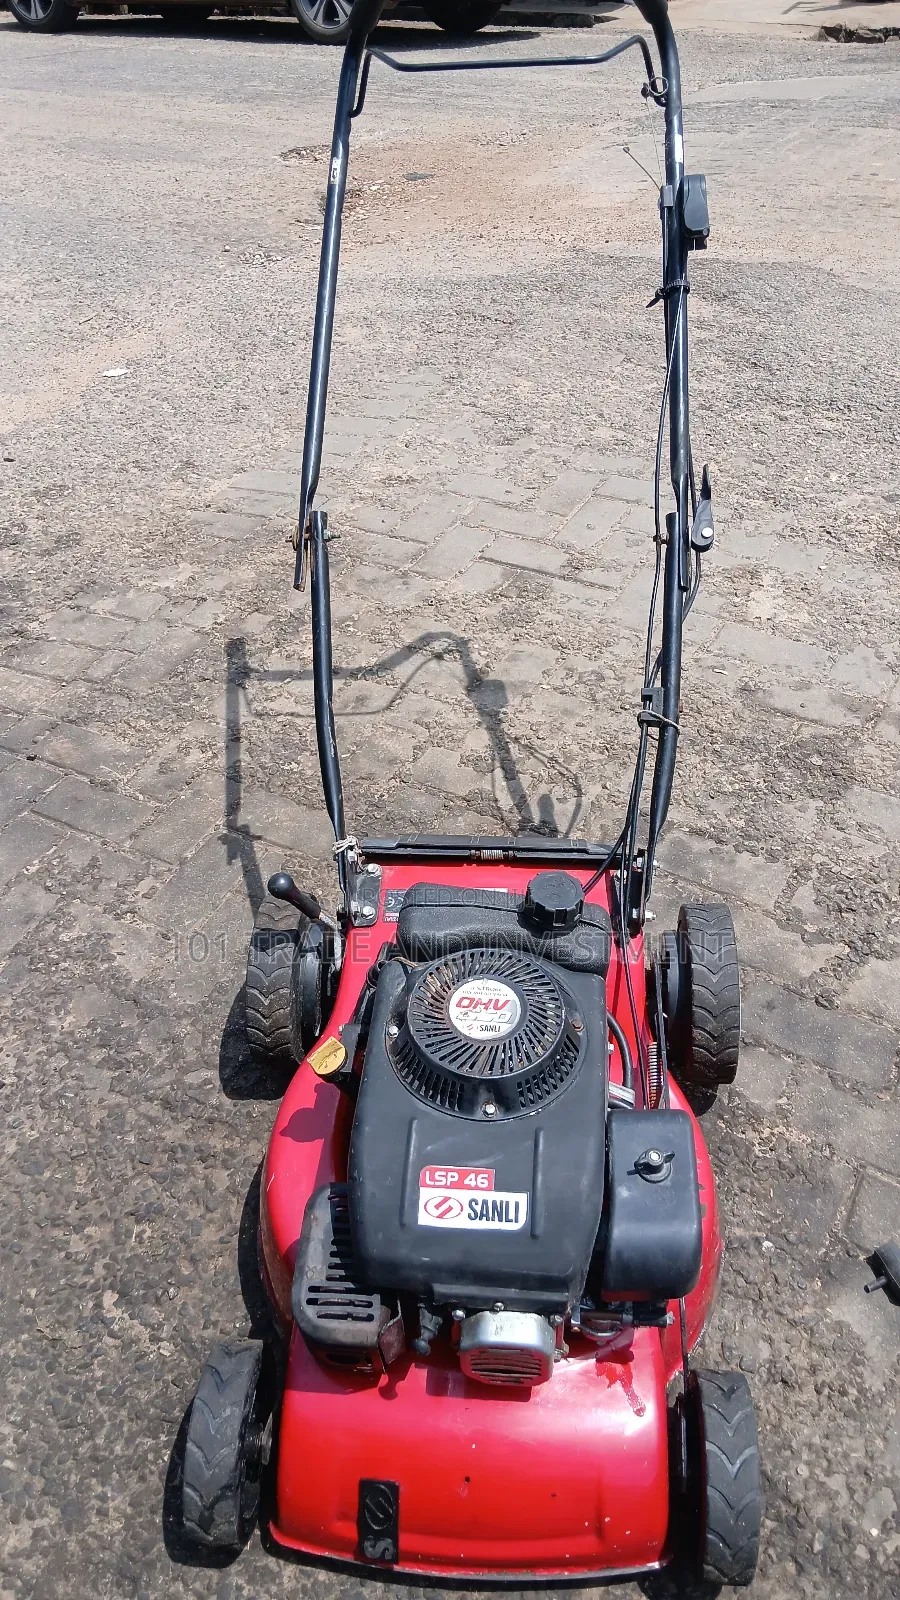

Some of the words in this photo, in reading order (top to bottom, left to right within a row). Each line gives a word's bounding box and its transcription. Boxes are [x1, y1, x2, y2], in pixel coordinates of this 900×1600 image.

[479, 1024, 501, 1033] SANLI
[424, 1170, 459, 1187] LSP
[463, 1172, 489, 1189] 46
[467, 1197, 520, 1224] SANLI
